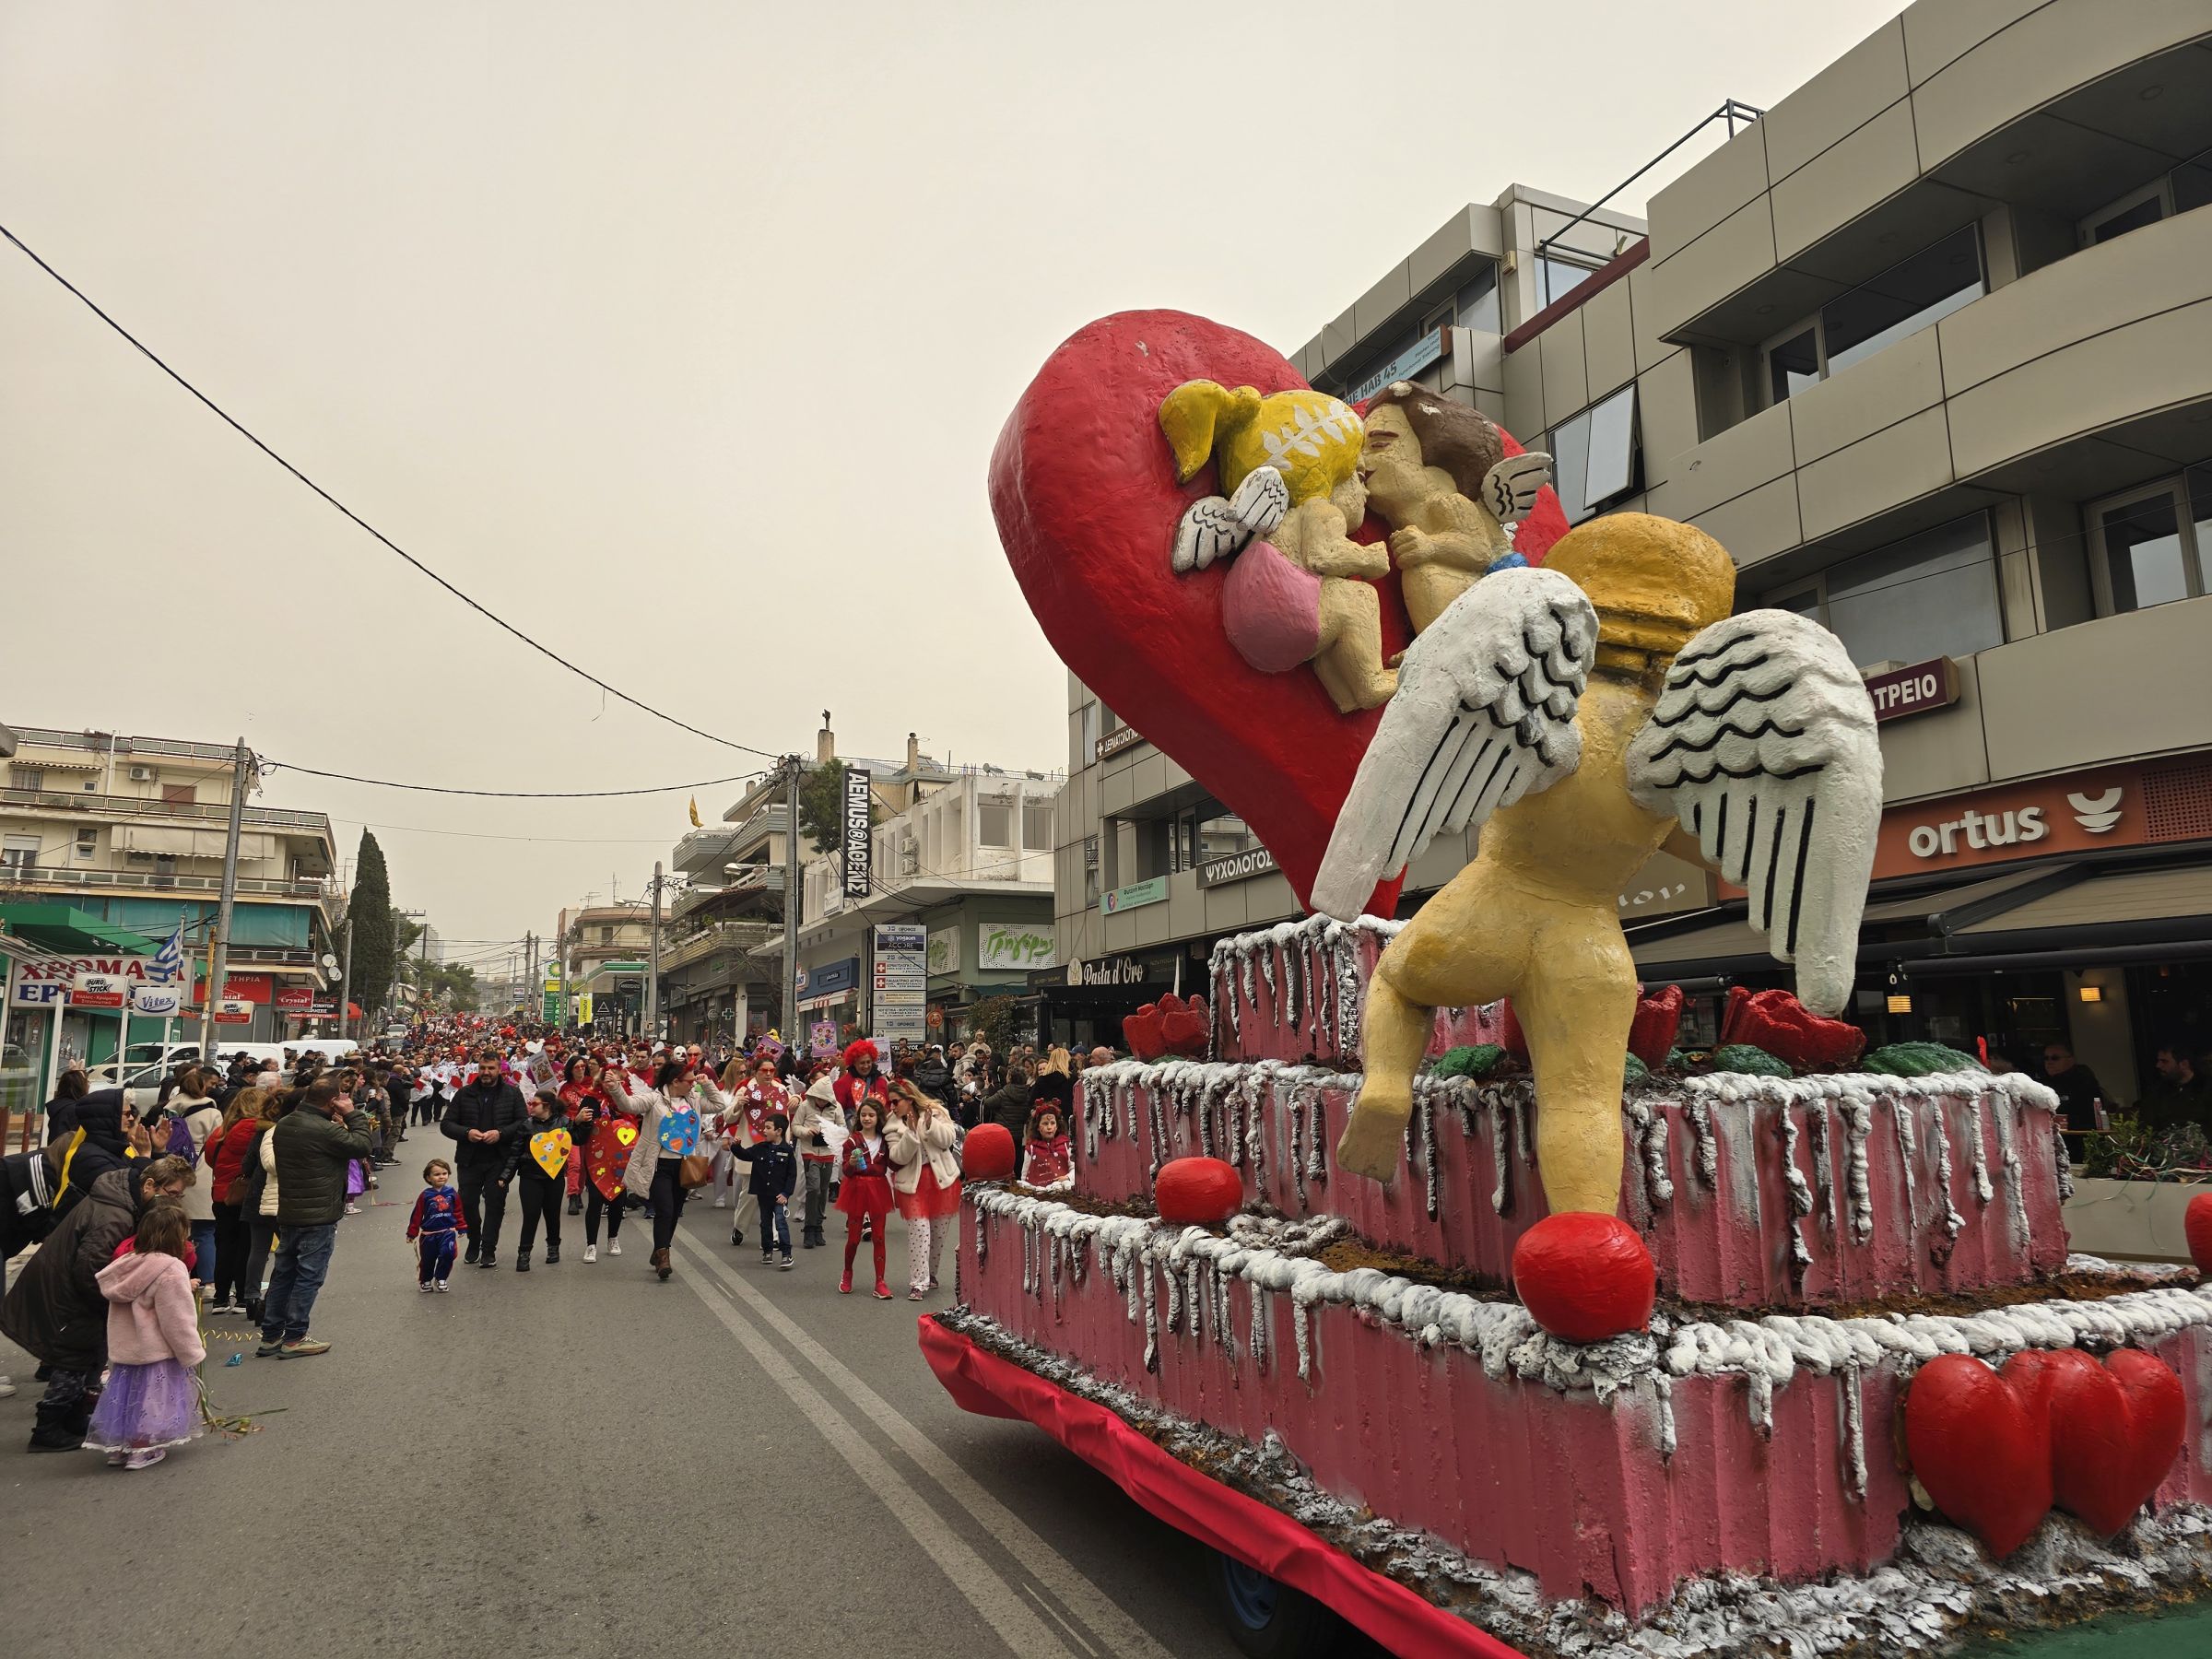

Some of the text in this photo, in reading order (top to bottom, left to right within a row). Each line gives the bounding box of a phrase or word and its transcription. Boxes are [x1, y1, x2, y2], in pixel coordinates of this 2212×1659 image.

[1345, 361, 1397, 406] HE HAB 45
[1909, 806, 2048, 857] ortus
[1206, 850, 1272, 882] ΨΥΧΟΛΟΓΟΣ
[1084, 957, 1143, 985] Pasta d'Oro
[89, 984, 109, 993] STICK
[142, 995, 172, 1008] Vitex
